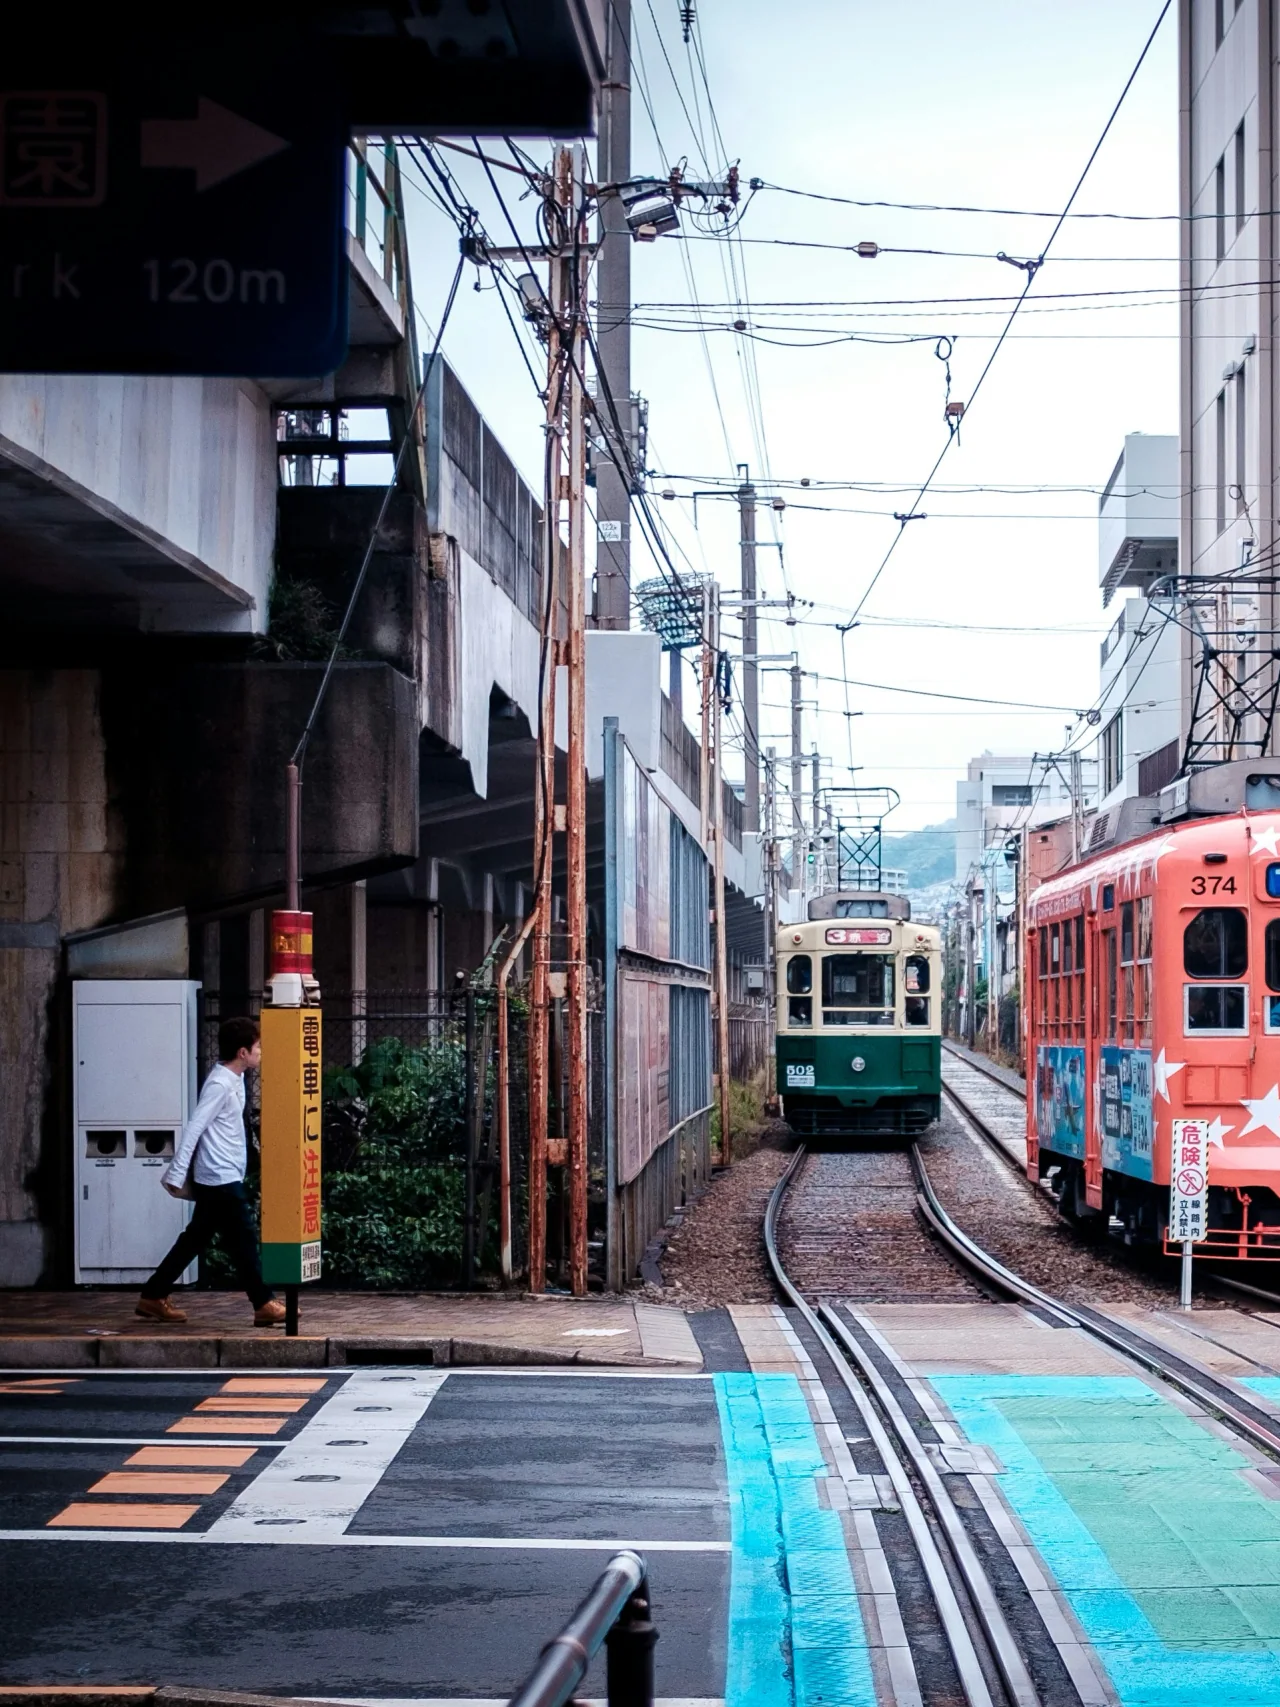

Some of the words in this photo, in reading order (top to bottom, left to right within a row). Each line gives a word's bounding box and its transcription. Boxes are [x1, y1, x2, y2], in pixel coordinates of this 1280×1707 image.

[142, 257, 287, 304] 120m
[1191, 875, 1238, 896] 374
[827, 929, 846, 944] 3
[787, 1065, 815, 1076] 502
[302, 1016, 319, 1234] 電車に注意
[1182, 1125, 1201, 1166] 危険
[1179, 1200, 1188, 1236] 立入禁止
